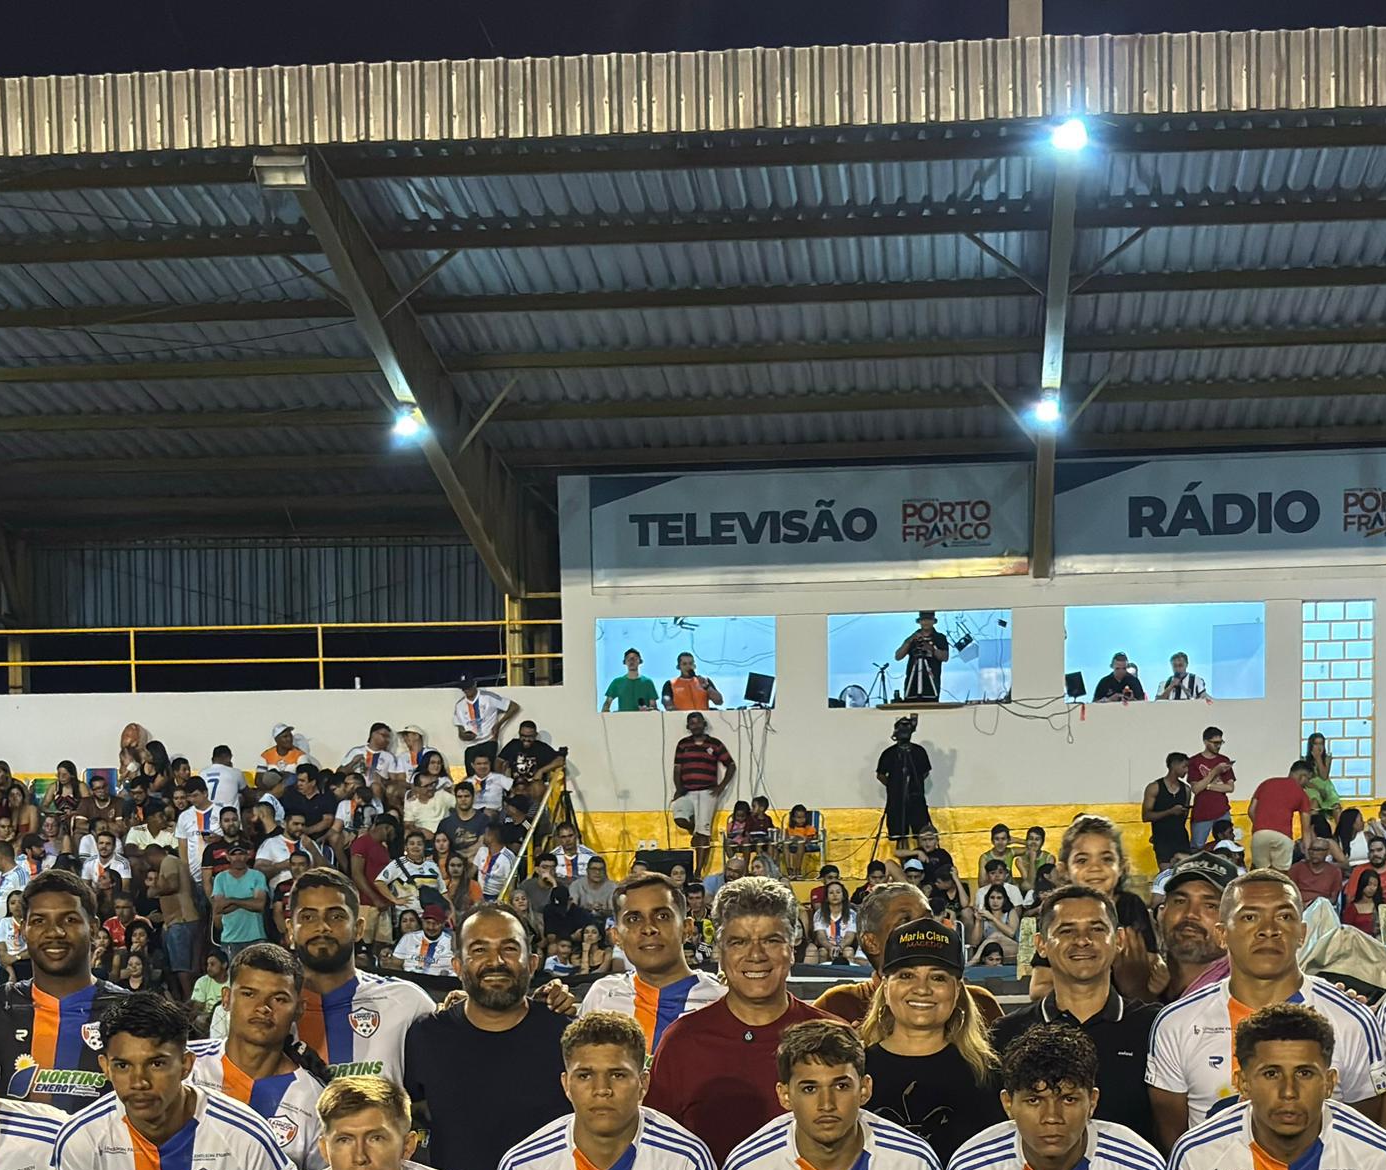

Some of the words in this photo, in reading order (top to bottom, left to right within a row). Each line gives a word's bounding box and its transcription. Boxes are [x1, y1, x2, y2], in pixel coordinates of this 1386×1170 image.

[902, 500, 991, 524] PORTO
[1128, 481, 1321, 538] RÁDIO
[629, 500, 878, 547] TELEVISÃO
[903, 522, 991, 548] FRANCO
[899, 931, 925, 945] Maria
[926, 931, 950, 944] Clara
[36, 1070, 106, 1087] NORTINS
